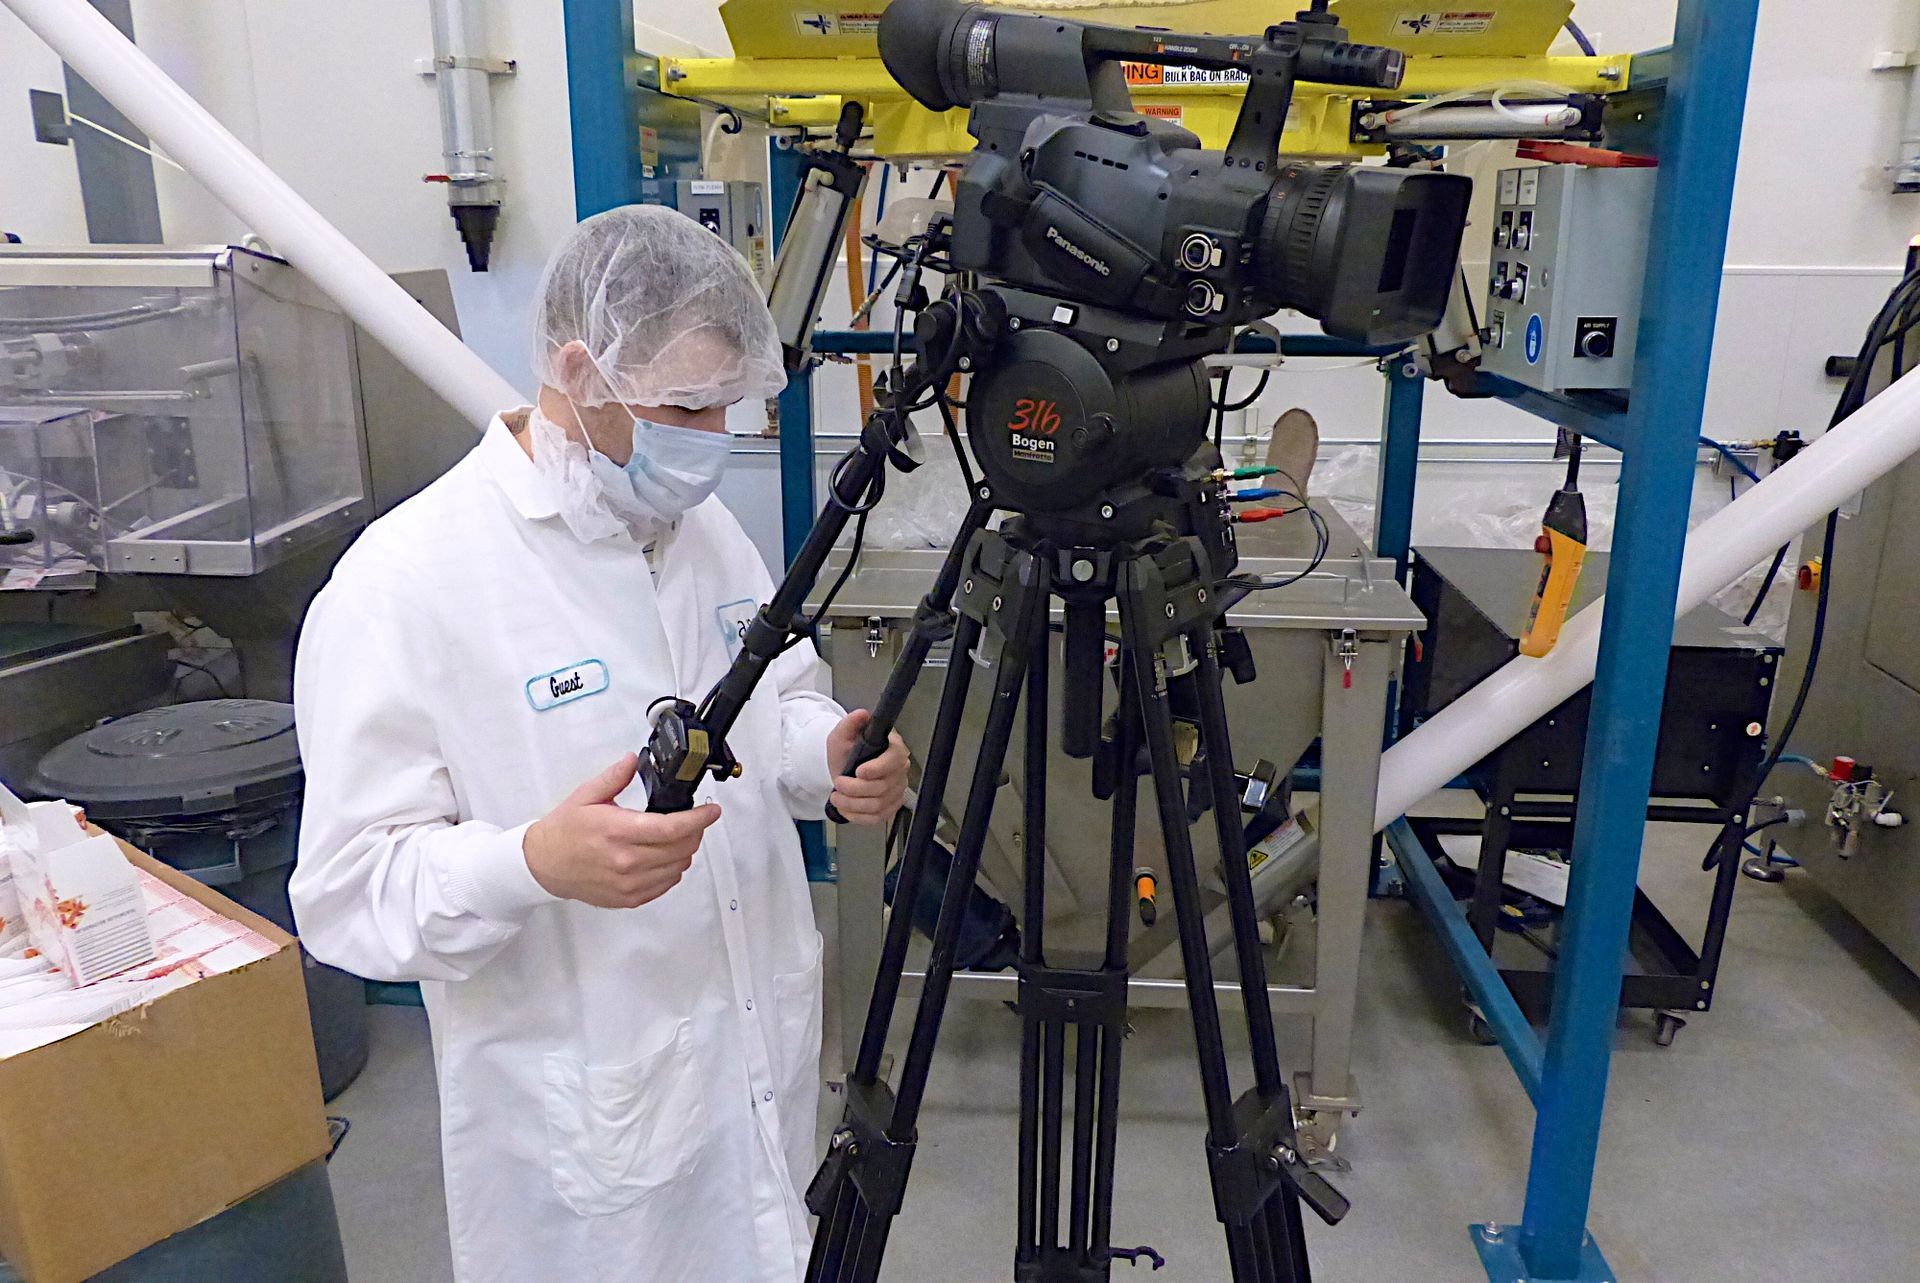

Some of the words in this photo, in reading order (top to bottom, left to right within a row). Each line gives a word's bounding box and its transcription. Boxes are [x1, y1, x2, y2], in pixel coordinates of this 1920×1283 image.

[1123, 63, 1159, 80] ING
[1165, 71, 1187, 82] BULK
[1189, 70, 1207, 82] BAG
[1209, 70, 1221, 82] ON
[1145, 107, 1180, 117] WARNING
[1046, 226, 1110, 276] Panasonic
[1007, 399, 1061, 435] 316
[1012, 433, 1055, 451] Bogen
[550, 671, 584, 698] Guest
